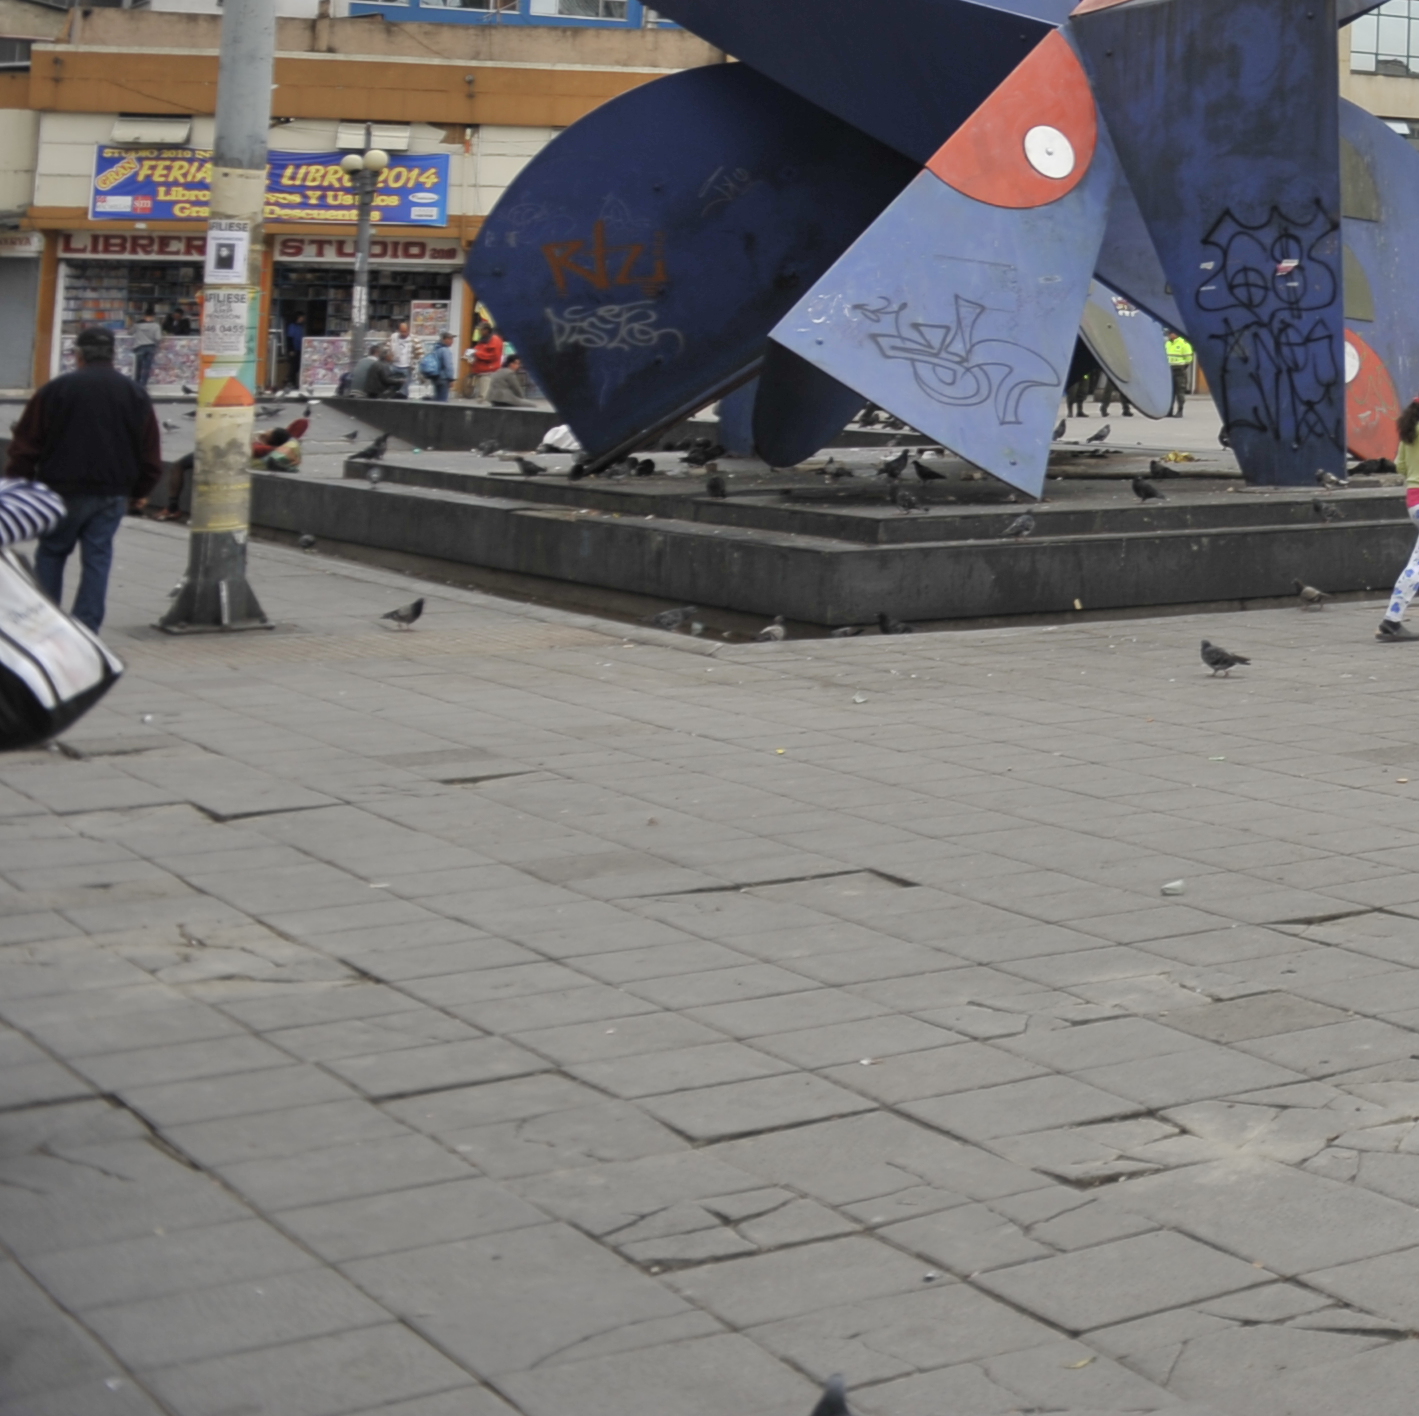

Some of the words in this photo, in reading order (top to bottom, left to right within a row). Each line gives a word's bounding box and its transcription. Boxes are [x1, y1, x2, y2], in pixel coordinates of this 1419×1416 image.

[97, 157, 138, 188] GRAN
[137, 160, 212, 183] FERIA
[263, 205, 381, 221] Descuents
